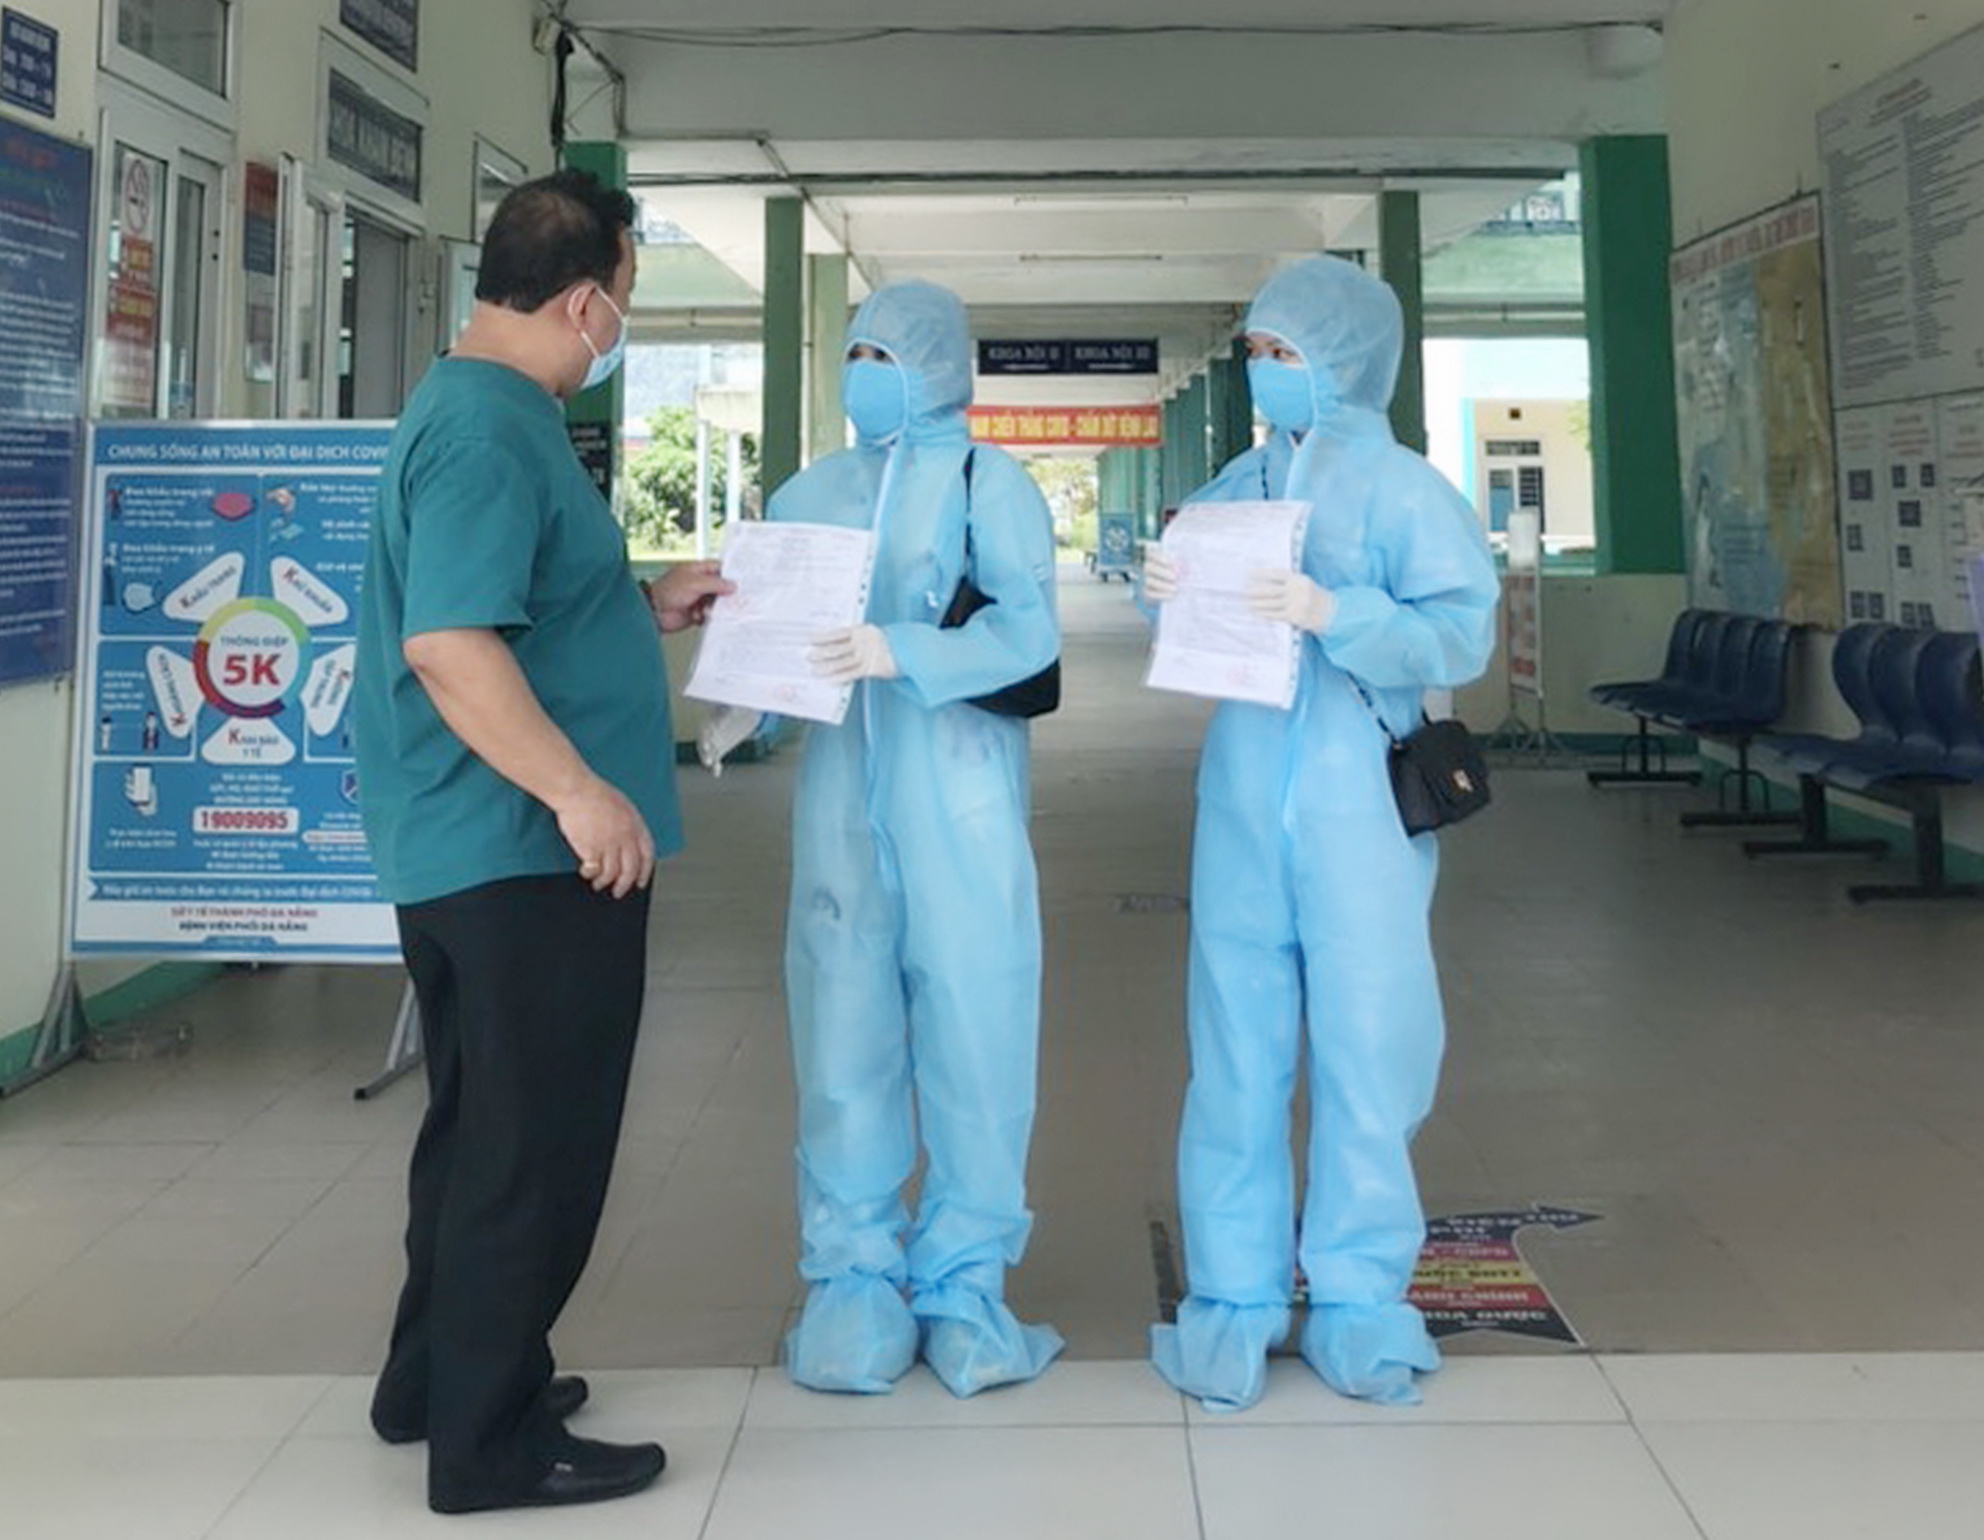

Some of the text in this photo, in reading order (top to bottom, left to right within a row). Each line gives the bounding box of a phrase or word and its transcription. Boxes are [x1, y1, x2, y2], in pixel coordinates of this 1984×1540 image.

[107, 443, 158, 460] CHUNG
[159, 441, 195, 460] SỐNG
[201, 444, 221, 460] AN
[223, 441, 261, 460] TOÀN
[315, 443, 350, 462] DỊCH
[223, 652, 283, 687] 5K
[201, 810, 289, 830] 19009095
[1425, 1309, 1468, 1320] HOA
